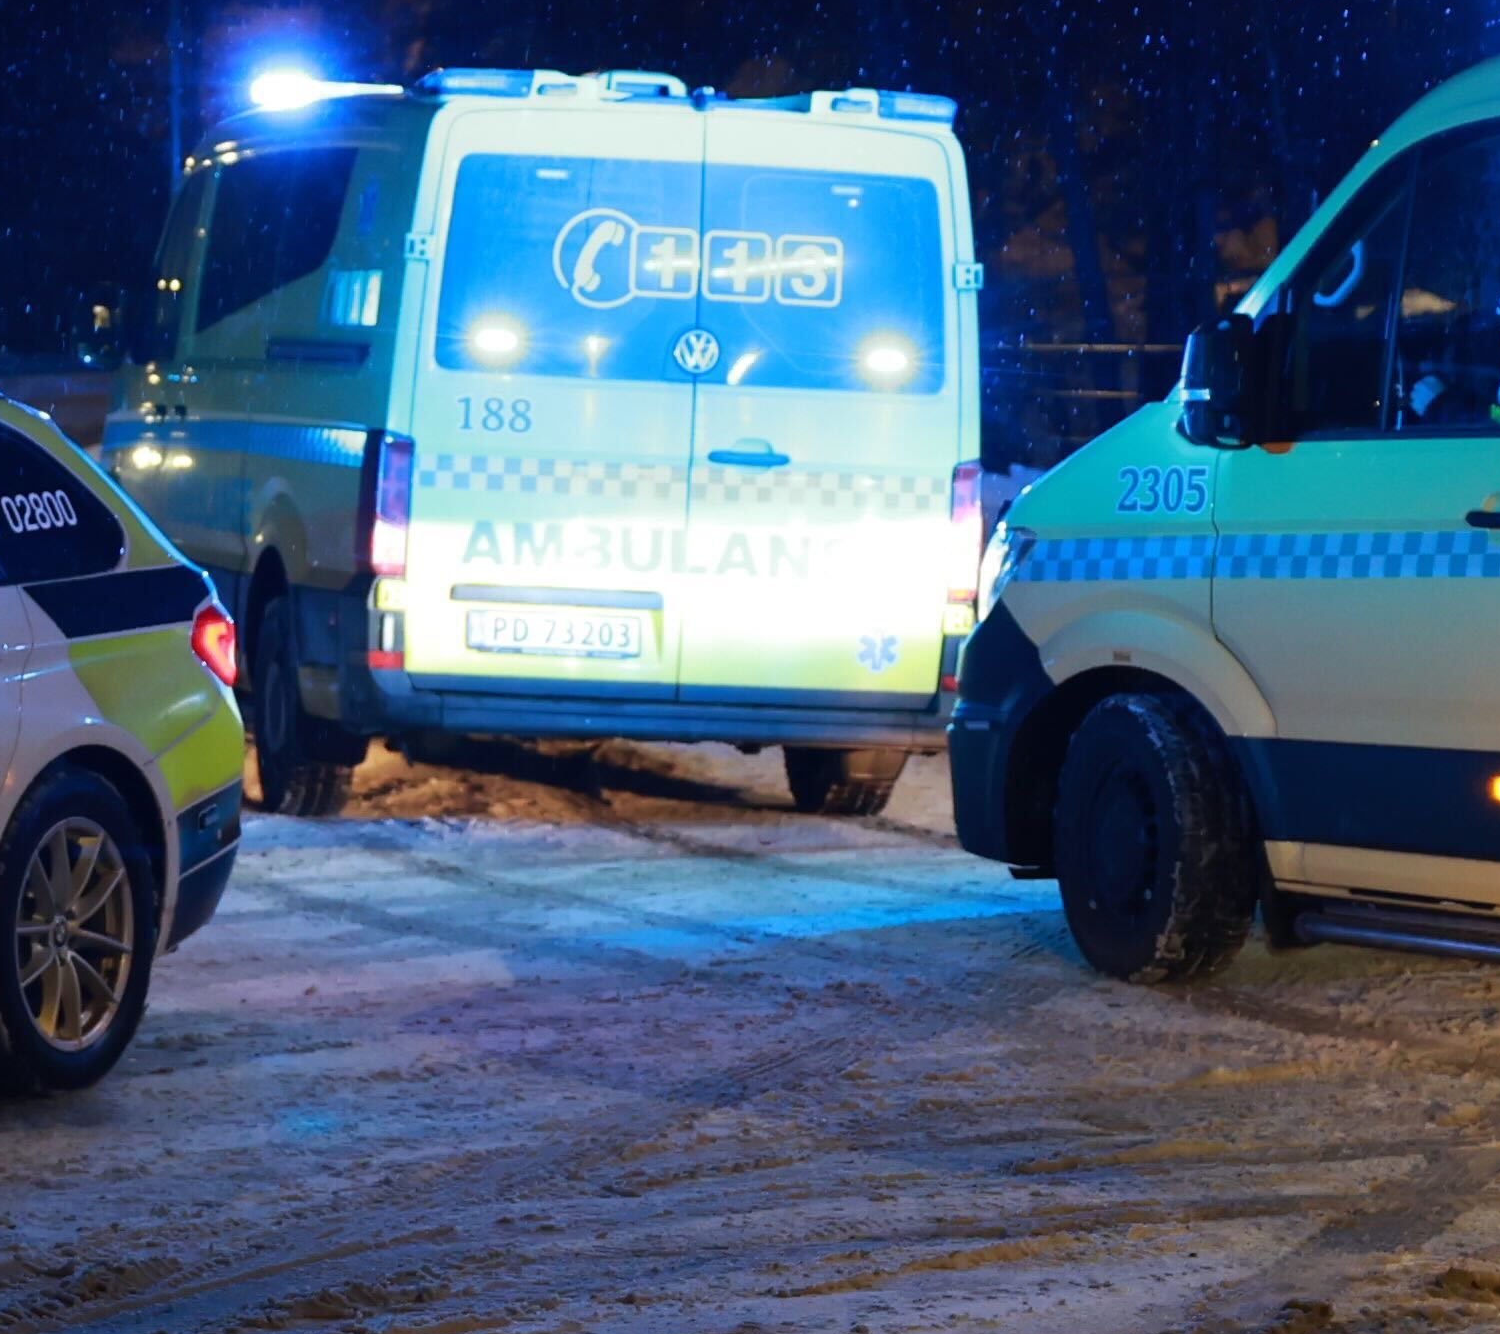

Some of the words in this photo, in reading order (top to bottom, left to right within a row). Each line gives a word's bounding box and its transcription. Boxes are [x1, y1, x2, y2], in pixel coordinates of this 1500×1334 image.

[456, 396, 533, 433] 188
[1116, 466, 1208, 513] 2305
[1, 488, 78, 534] 02800
[493, 616, 530, 643] PD
[544, 618, 631, 649] 73203
